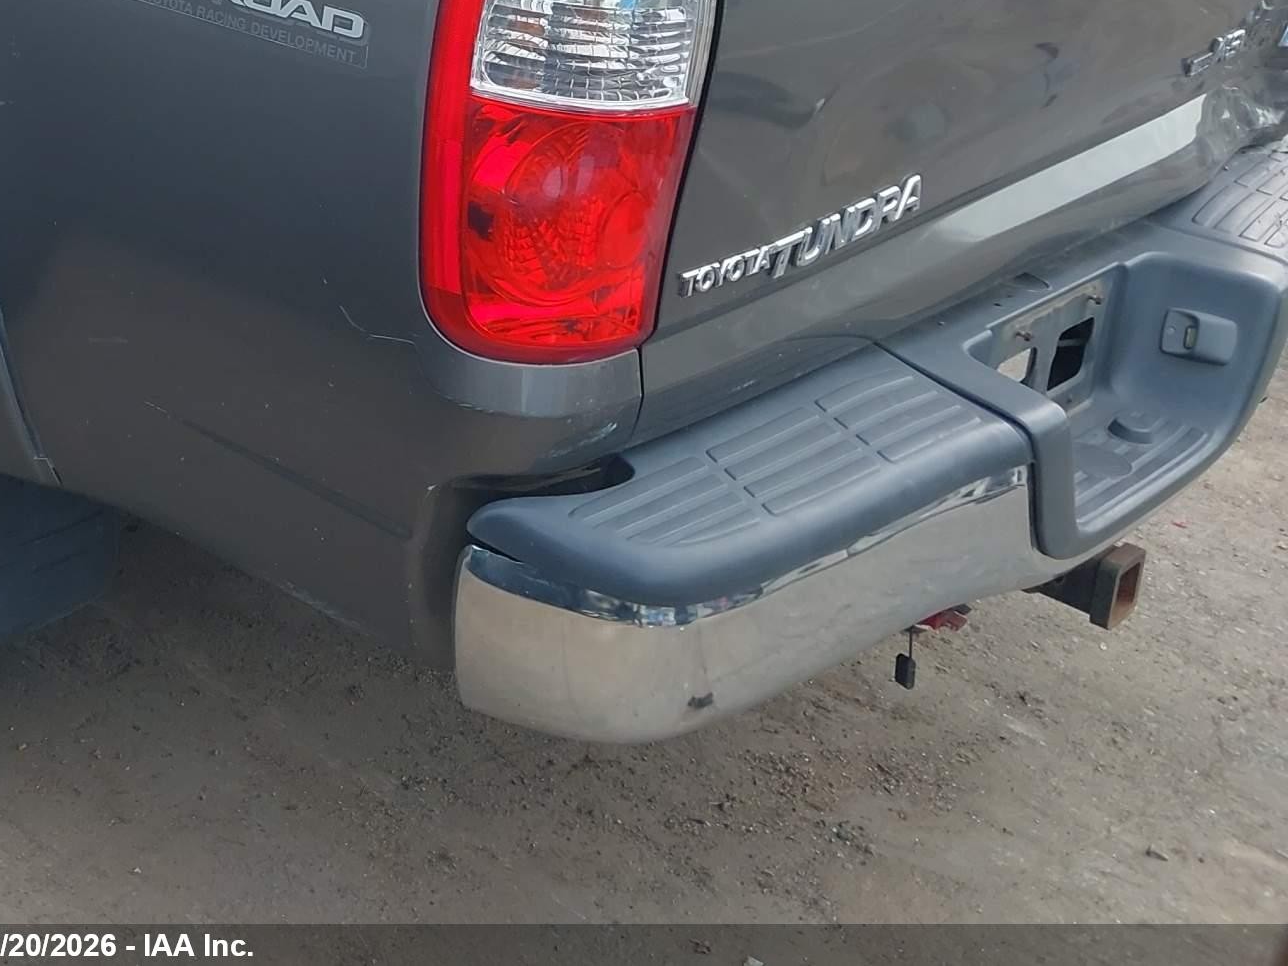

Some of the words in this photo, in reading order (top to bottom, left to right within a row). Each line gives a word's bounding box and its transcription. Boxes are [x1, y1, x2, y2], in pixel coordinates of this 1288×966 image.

[196, 5, 247, 31] RACING
[250, 21, 357, 63] DEVELOPMENT
[680, 244, 772, 298] TOYOTA
[766, 174, 922, 279] TUNDRA
